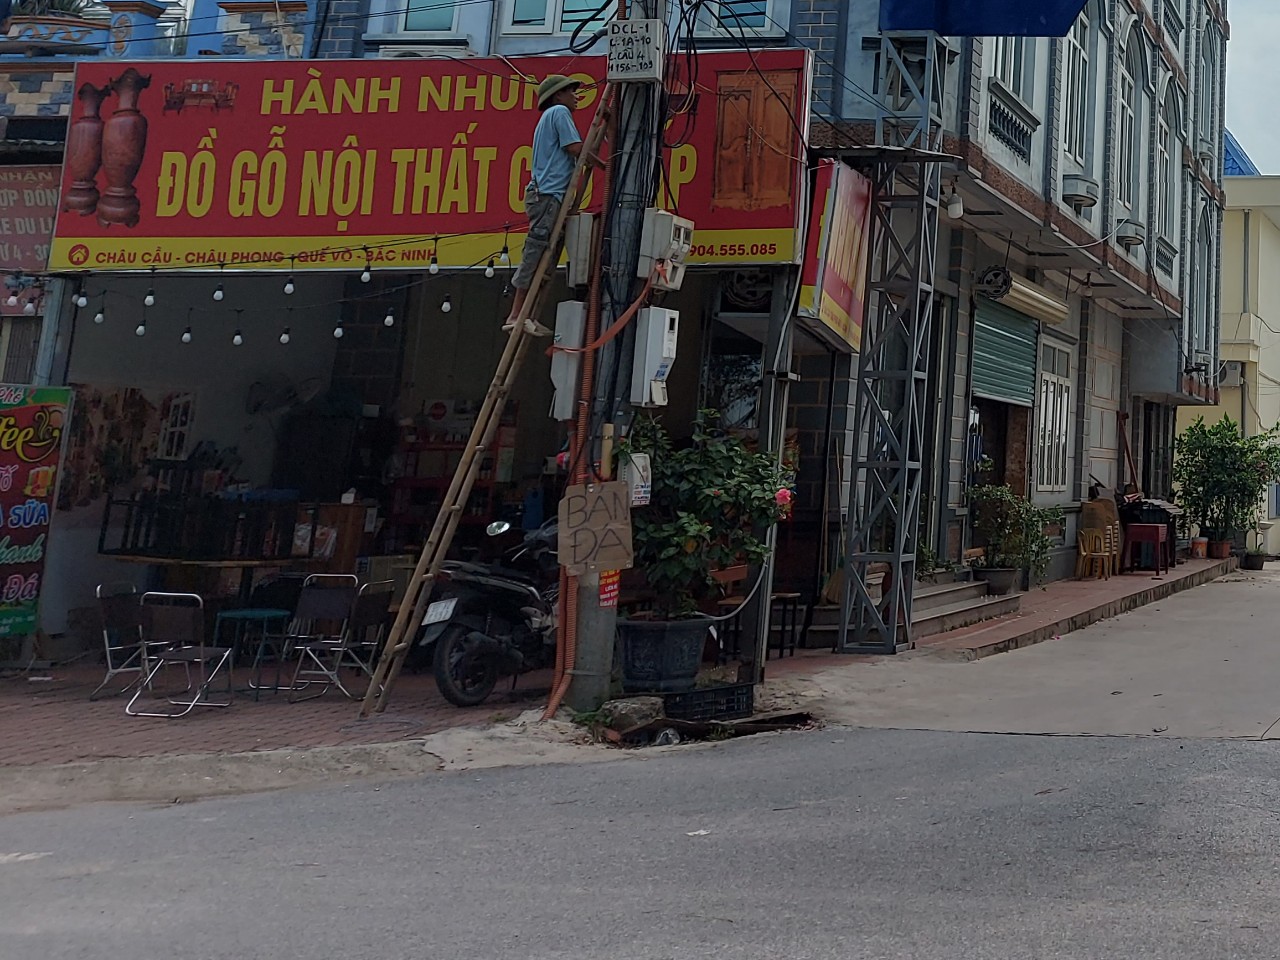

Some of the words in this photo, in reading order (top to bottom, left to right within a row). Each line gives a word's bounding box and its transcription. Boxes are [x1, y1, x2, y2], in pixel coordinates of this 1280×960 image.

[260, 67, 401, 115] HÀNH
[156, 127, 218, 218] ĐỒ
[228, 125, 288, 218] GỖ
[298, 135, 377, 232] NỘI
[391, 122, 497, 215] THẤT
[95, 248, 137, 264] CHÂU
[141, 246, 172, 264] CẦU
[184, 248, 227, 264] CHÂU
[230, 251, 284, 263] PHONG
[401, 249, 437, 262] NINH
[567, 485, 629, 529] BÁN
[570, 522, 631, 565] ĐÁ
